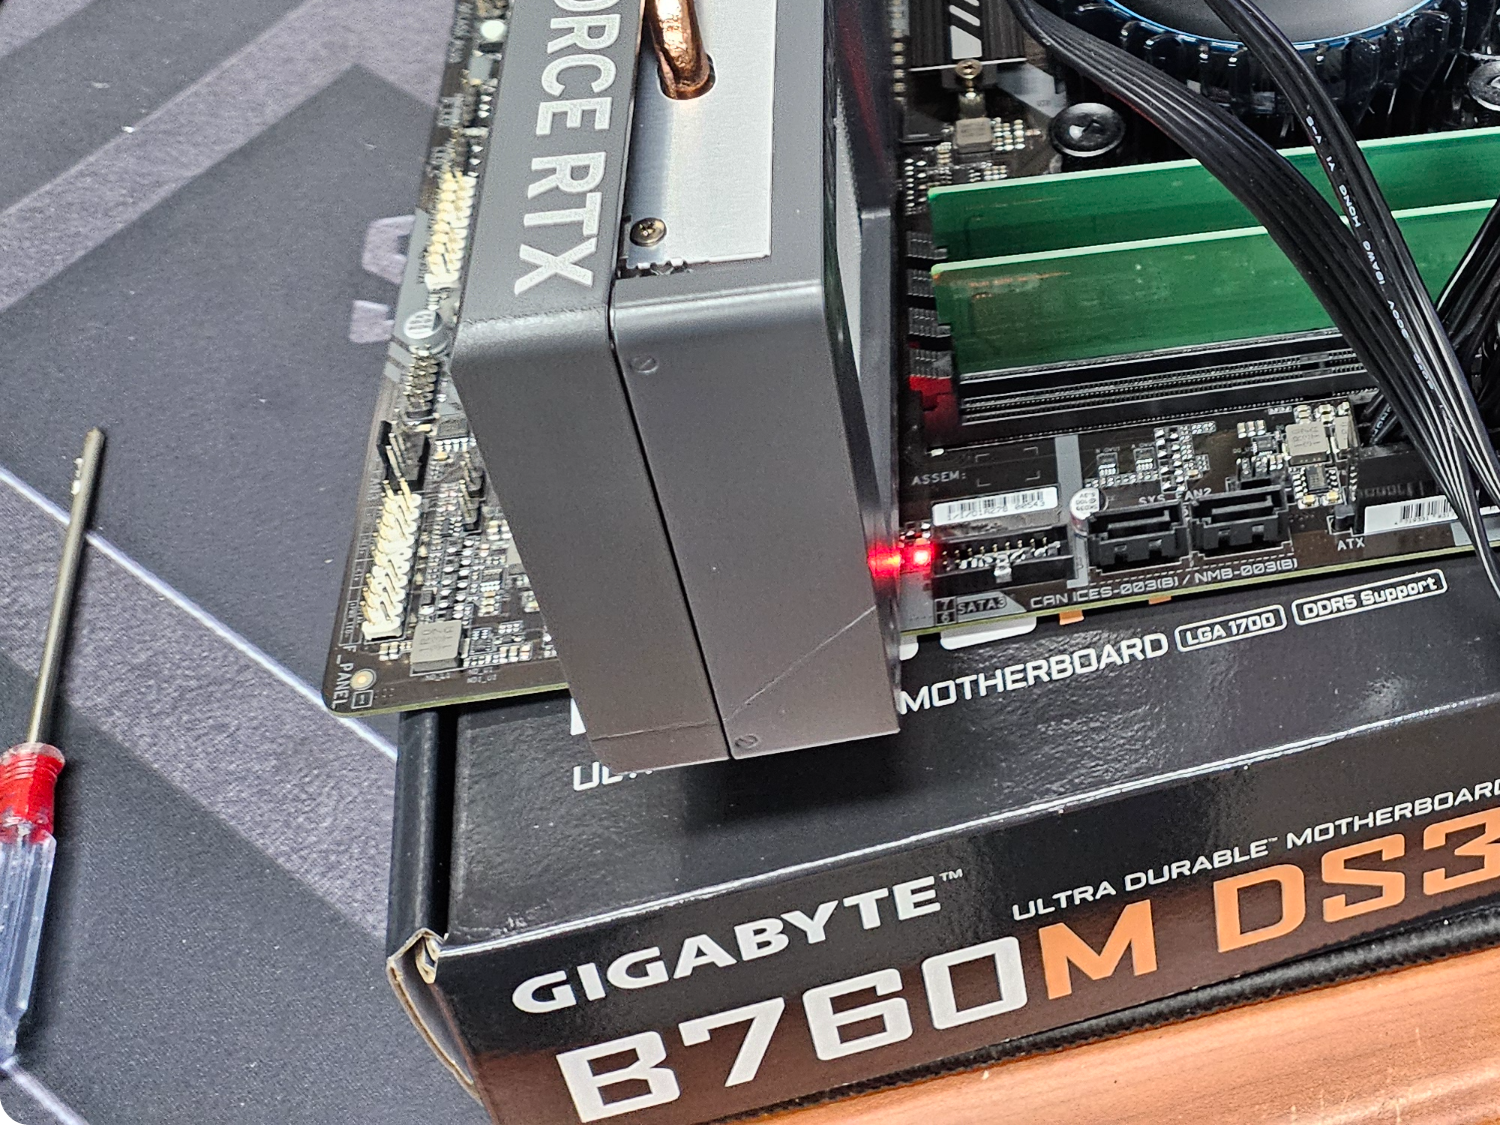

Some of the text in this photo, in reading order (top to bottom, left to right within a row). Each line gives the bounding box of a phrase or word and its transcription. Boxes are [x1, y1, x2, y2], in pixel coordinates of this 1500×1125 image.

[513, 151, 608, 296] RTX
[911, 469, 967, 487] ASSEM:
[1336, 536, 1366, 552] ATX
[957, 596, 1008, 616] SATA3
[1030, 593, 1069, 609] CAN
[1302, 575, 1440, 620] DDR5 Support
[1185, 611, 1276, 646] LGA 1700
[331, 645, 357, 710] F_PANEL
[899, 632, 1169, 715] MOTHERBOARD
[1012, 882, 1117, 921] ULTRA
[555, 900, 1159, 1124] B760M
